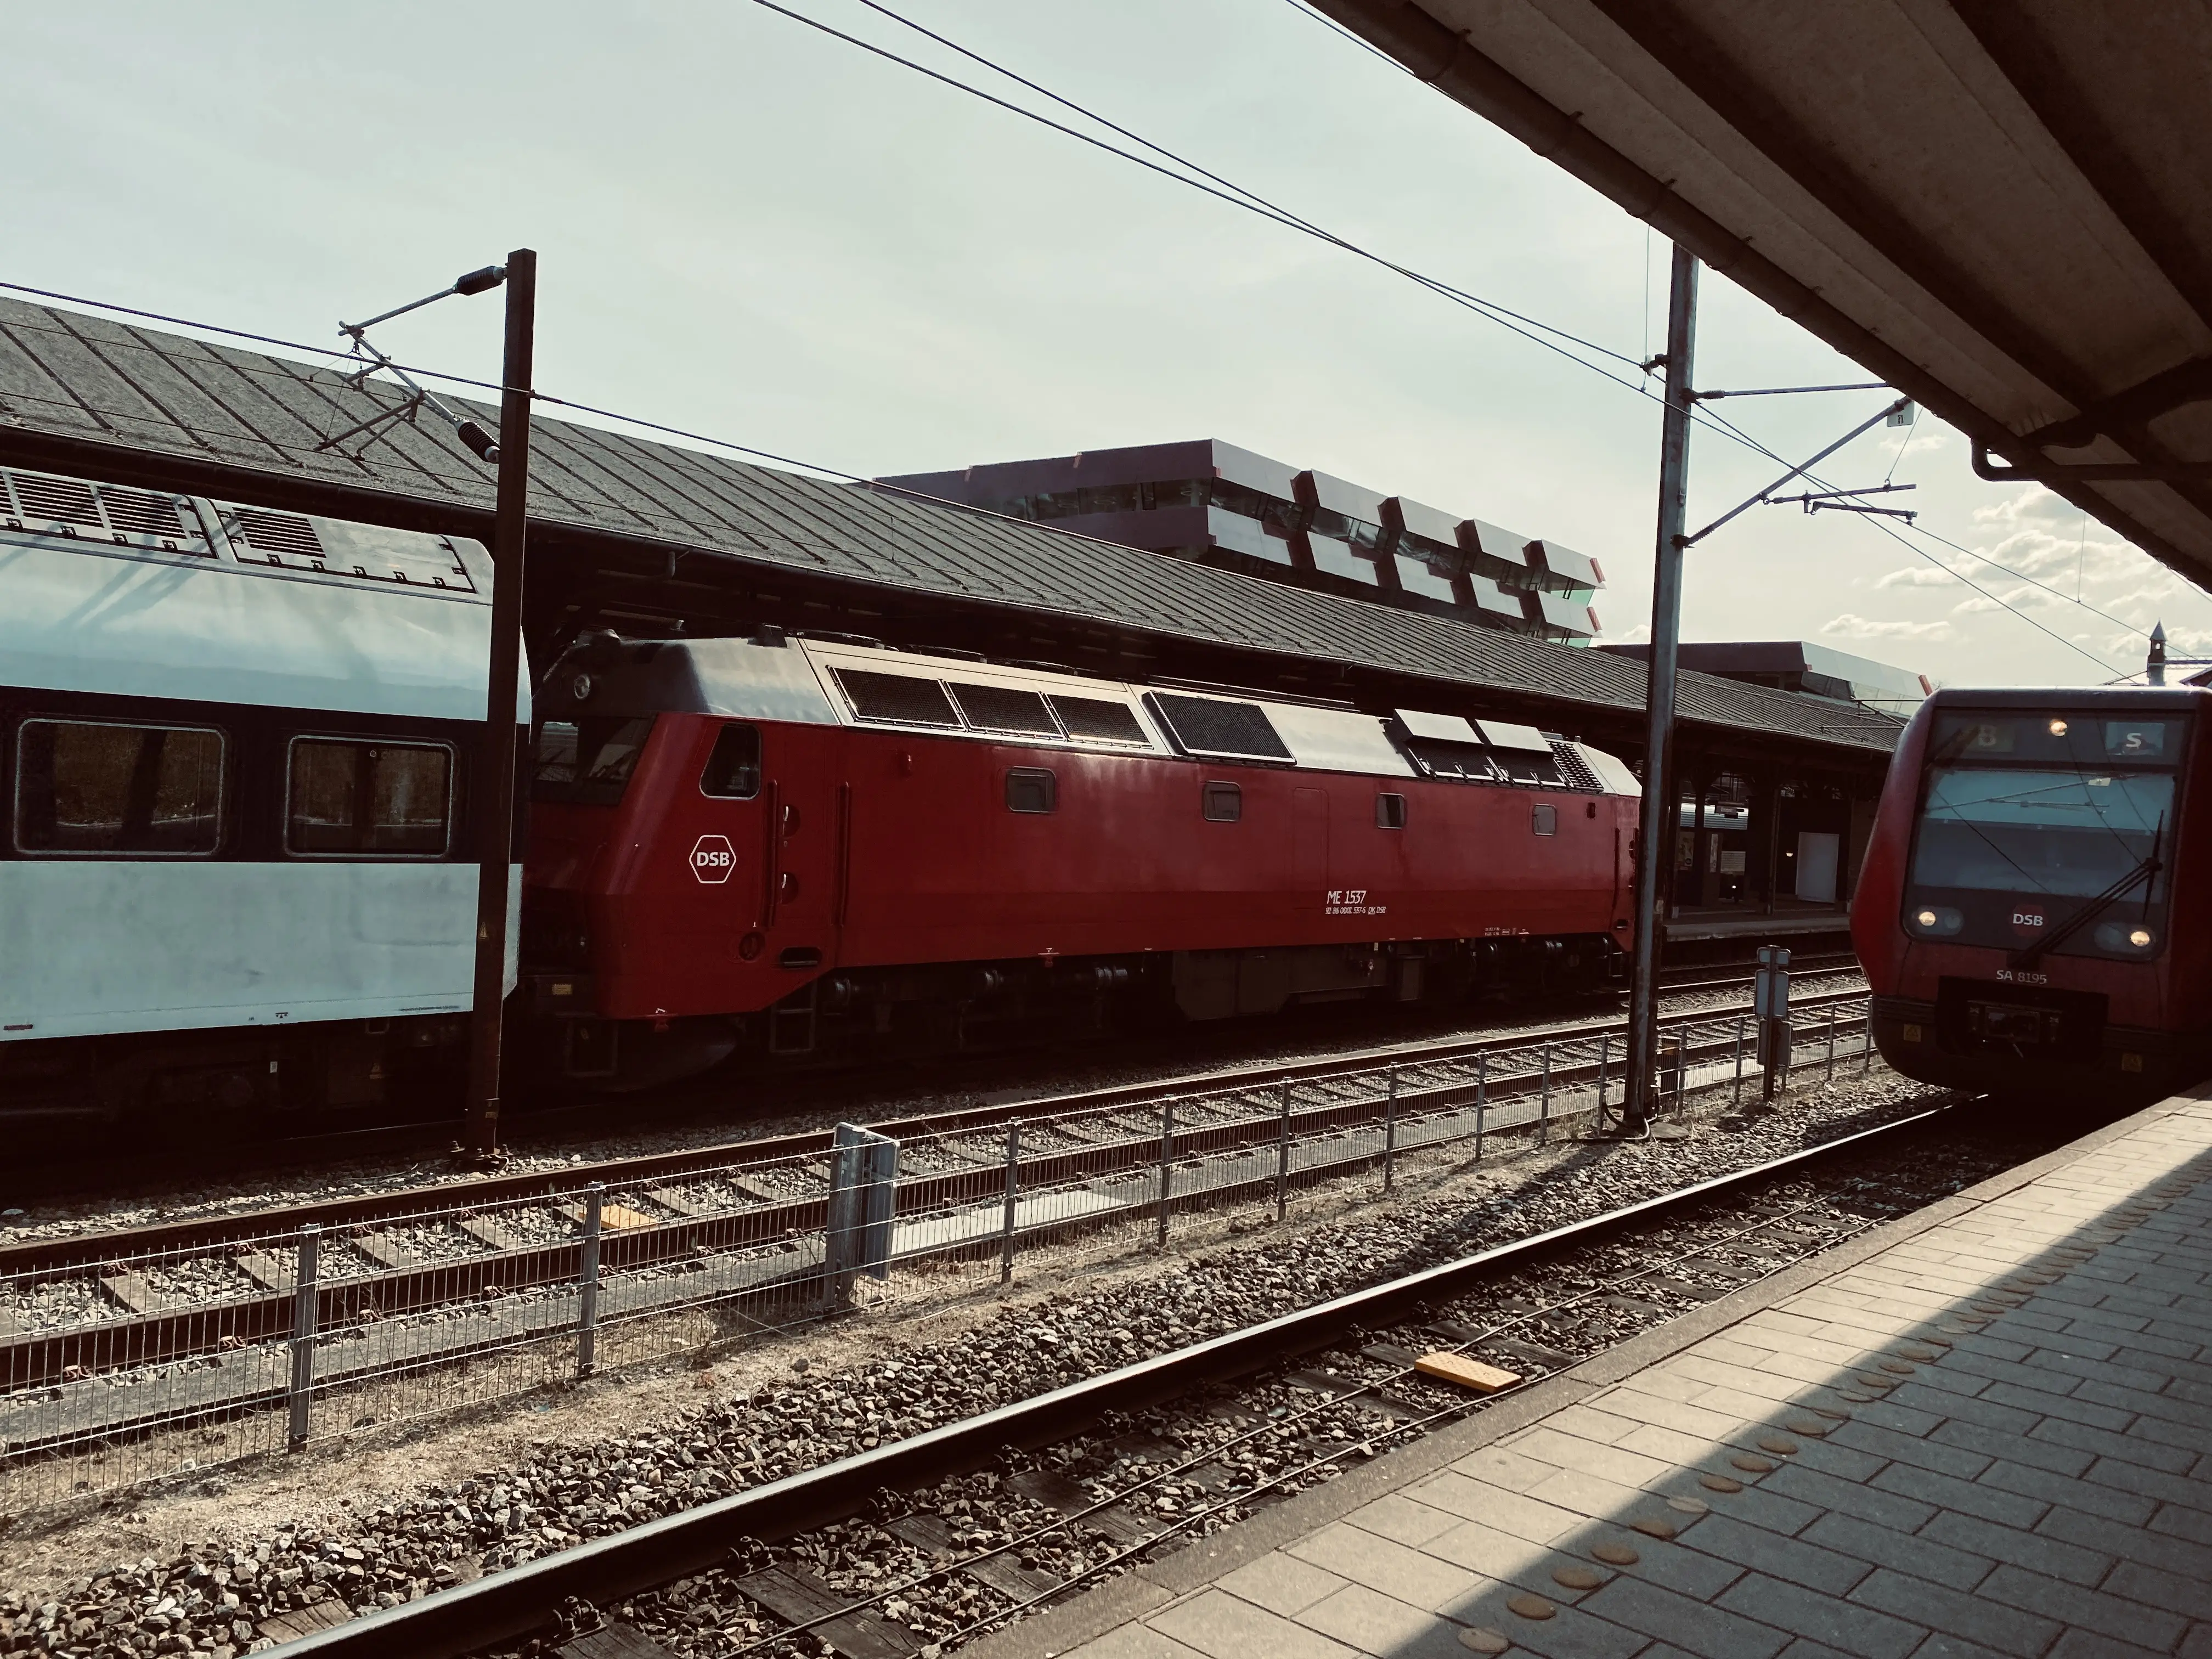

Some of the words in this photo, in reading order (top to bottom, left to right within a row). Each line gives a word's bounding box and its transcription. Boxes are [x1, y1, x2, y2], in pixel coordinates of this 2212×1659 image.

[2126, 732, 2141, 748] S
[697, 851, 730, 866] DSB
[1327, 890, 1342, 905] ME
[1344, 890, 1367, 904] 1537
[1368, 906, 1375, 915] DK
[2013, 913, 2043, 926] DSB
[1996, 970, 2013, 981] SA
[2018, 972, 2047, 985] 8195
